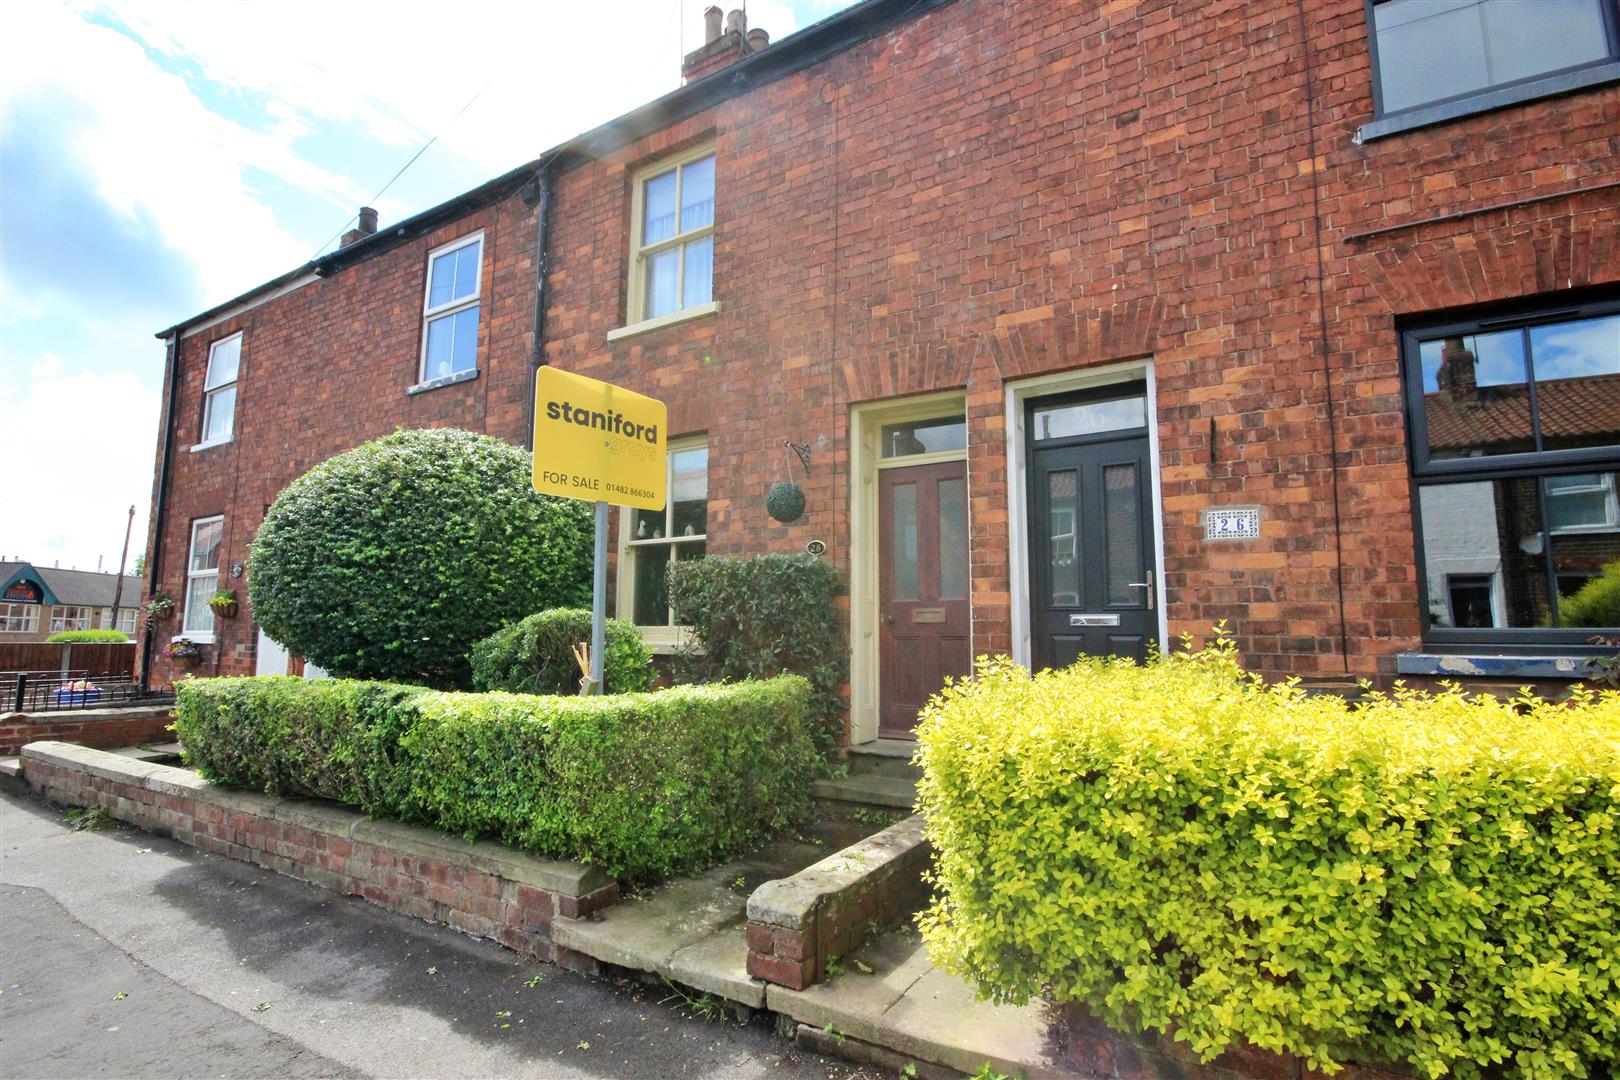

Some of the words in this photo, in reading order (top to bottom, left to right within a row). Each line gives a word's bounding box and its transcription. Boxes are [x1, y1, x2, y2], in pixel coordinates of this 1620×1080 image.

[547, 401, 657, 444] staniford
[543, 471, 568, 485] FOR
[572, 475, 600, 491] SALE
[606, 483, 628, 495] 01482
[629, 487, 655, 499] 866304
[810, 544, 822, 553] 28
